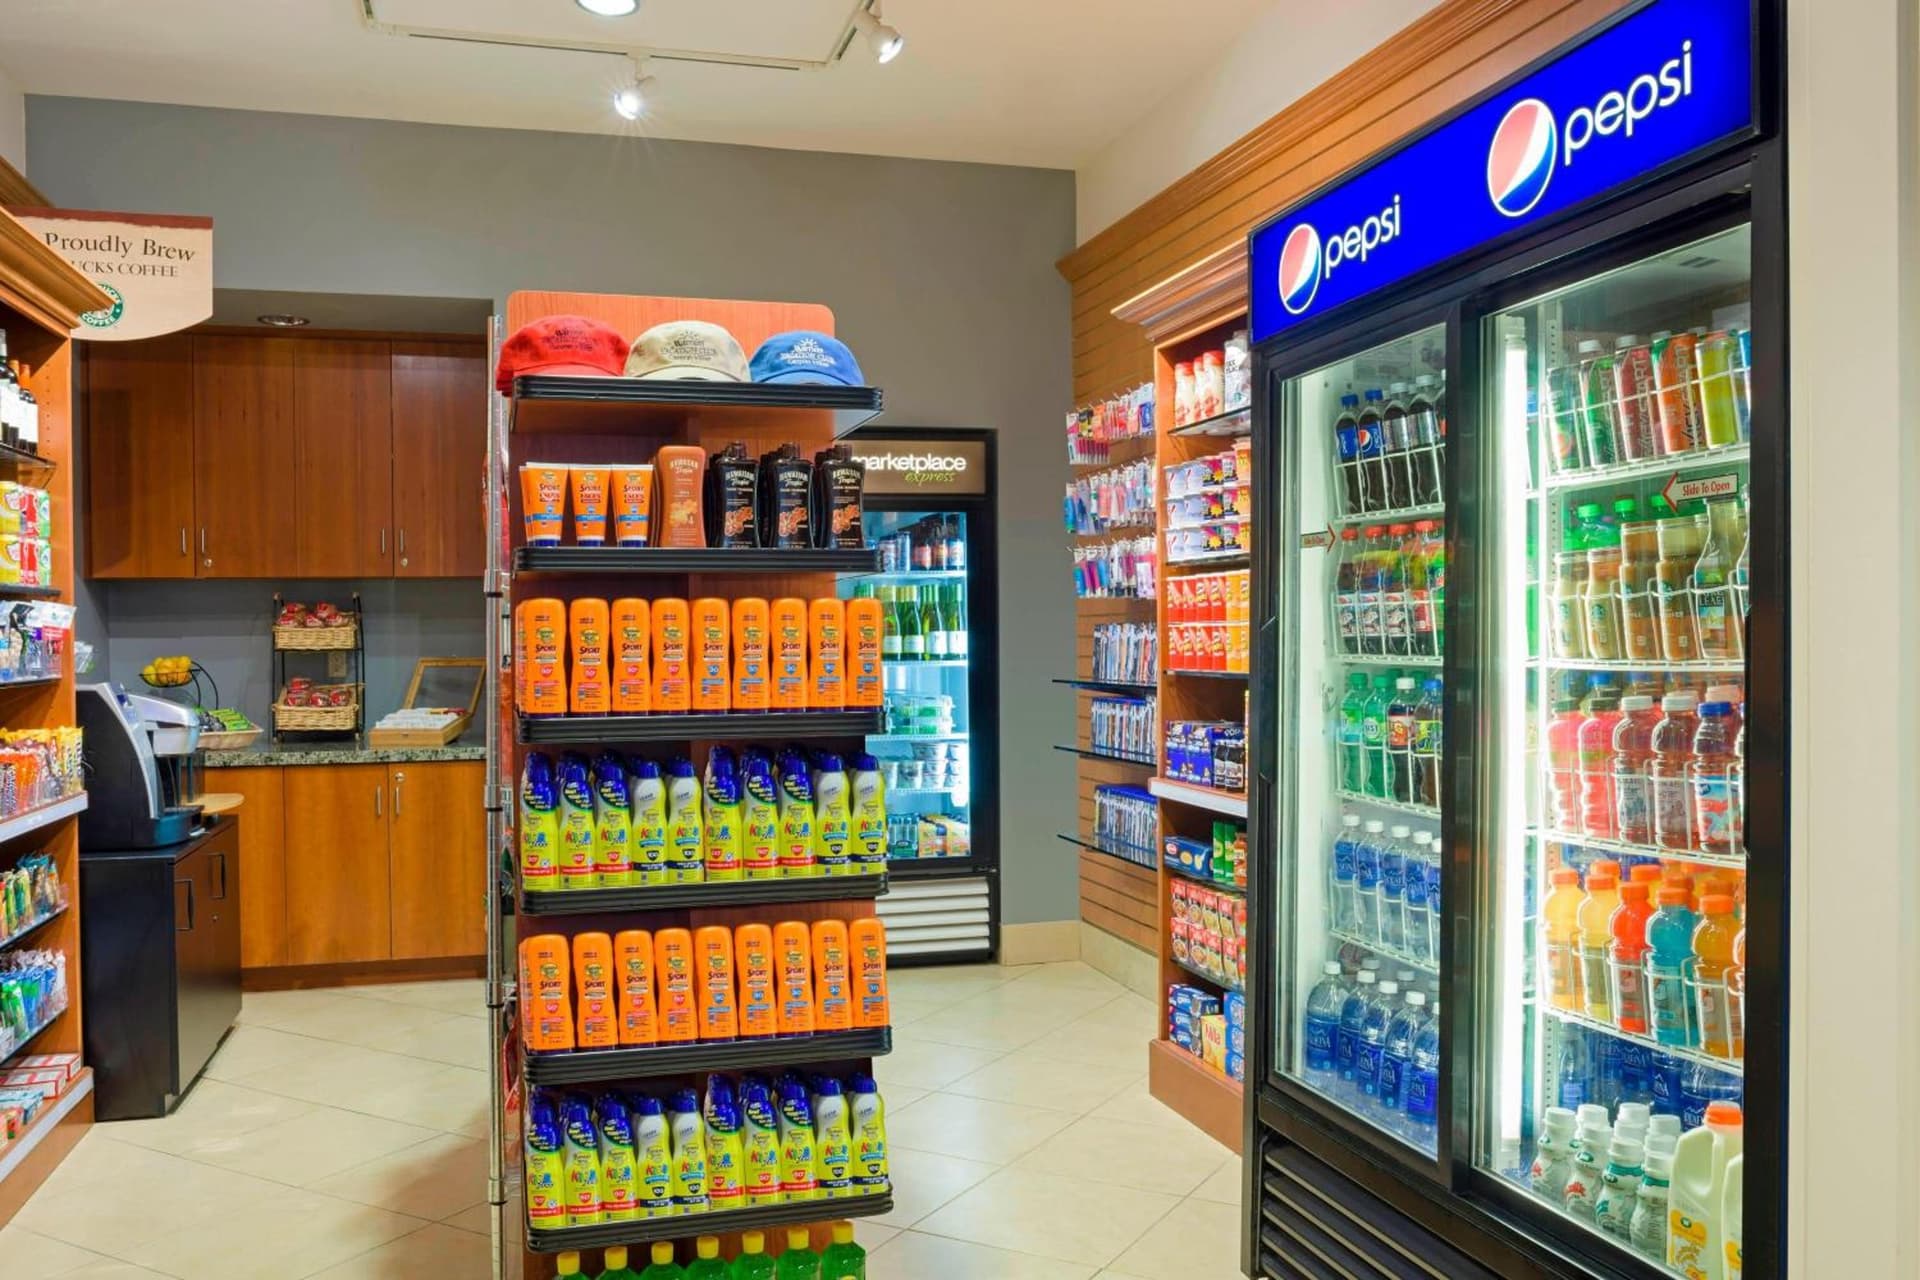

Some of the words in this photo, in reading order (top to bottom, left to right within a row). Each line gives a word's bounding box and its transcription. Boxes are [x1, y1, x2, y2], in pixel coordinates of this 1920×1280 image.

[1563, 40, 1693, 166] pepsi
[45, 232, 133, 258] Proudly
[143, 238, 196, 262] Brew
[1324, 195, 1401, 279] pepsi
[118, 262, 179, 278] COFFEE
[905, 472, 956, 487] express
